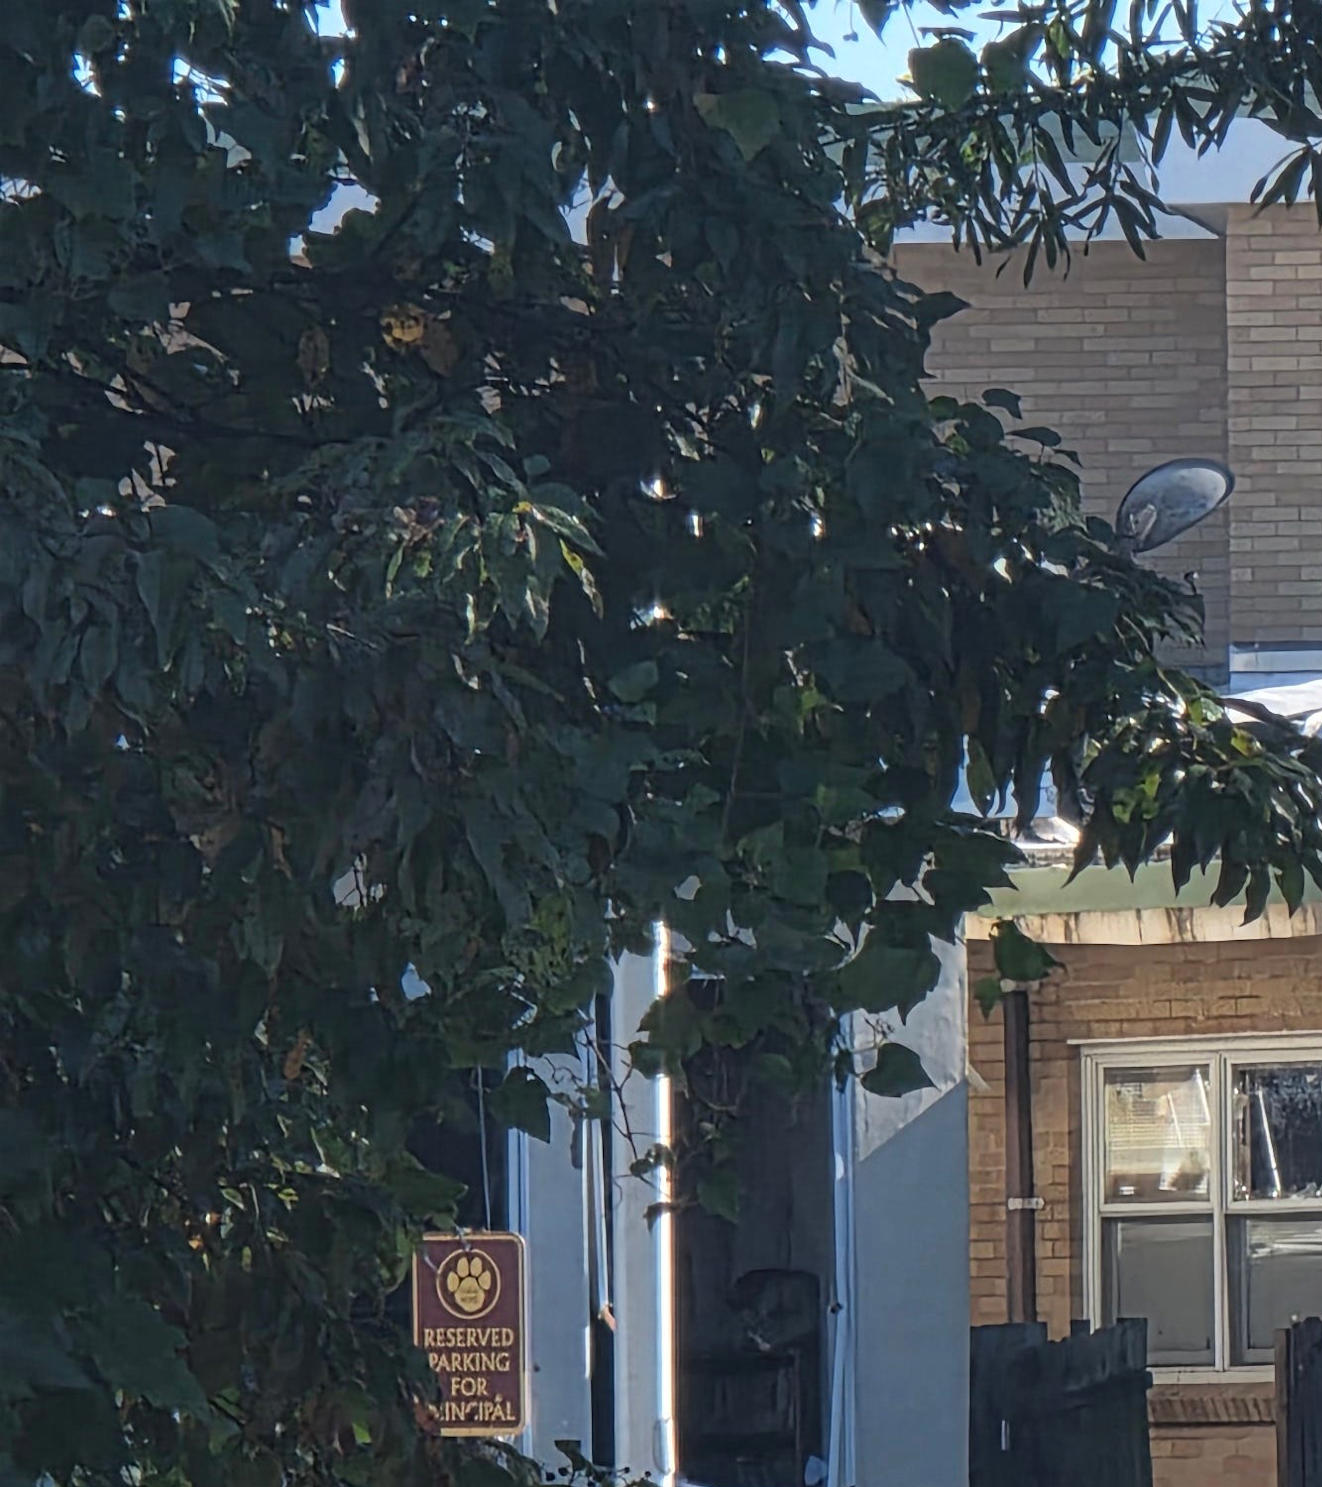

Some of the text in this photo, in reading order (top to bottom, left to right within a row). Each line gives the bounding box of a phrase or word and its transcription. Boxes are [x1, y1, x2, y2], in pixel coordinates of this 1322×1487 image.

[423, 1327, 515, 1348] RESERVED
[429, 1352, 510, 1372] PARKING
[451, 1377, 488, 1396] FOR
